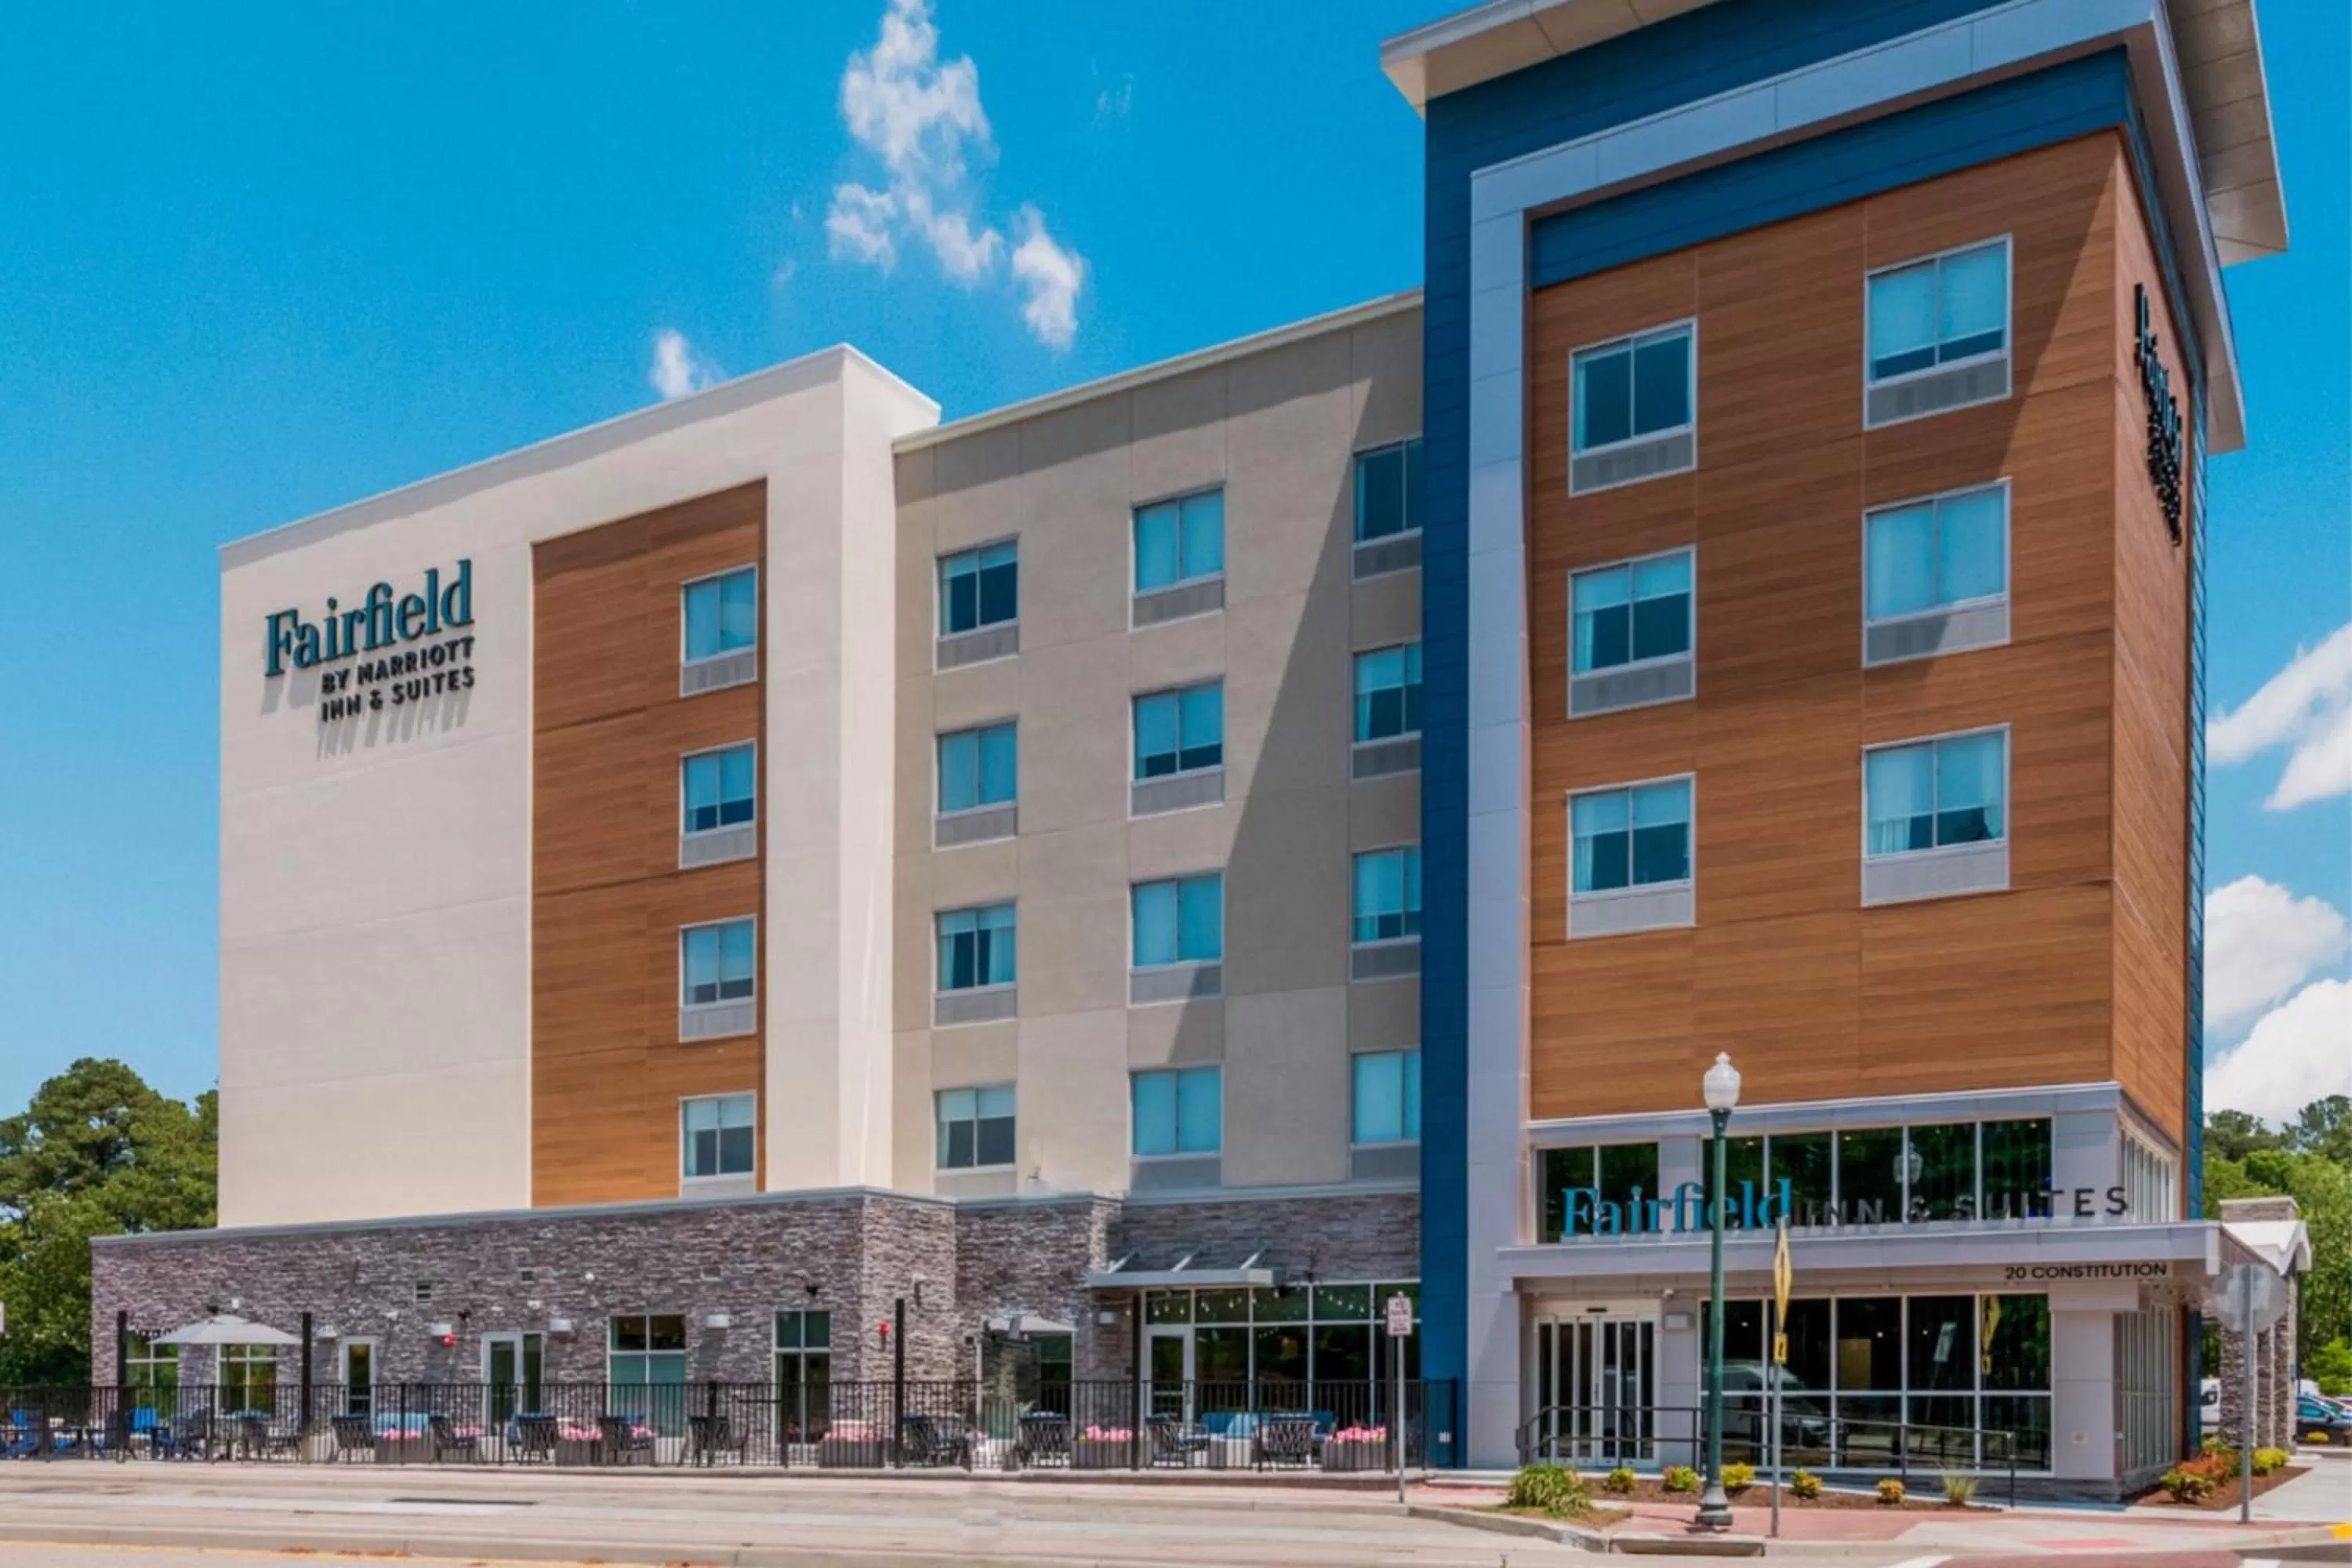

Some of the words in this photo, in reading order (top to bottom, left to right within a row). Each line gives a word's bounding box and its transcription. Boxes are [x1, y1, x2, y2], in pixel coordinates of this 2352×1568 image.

[264, 557, 475, 678] Fairfield
[321, 667, 350, 695] BY
[357, 635, 475, 686] MARRIOTT
[321, 693, 361, 723] INN
[368, 689, 383, 711] &
[391, 665, 475, 706] SUITES
[1561, 1178, 1792, 1237] Fairfield
[1806, 1197, 1885, 1226] INN
[1907, 1194, 1932, 1225] &
[1951, 1186, 2129, 1221] SUITES
[2004, 1265, 2027, 1280] 20
[2031, 1261, 2168, 1279] CONSTITUTION
